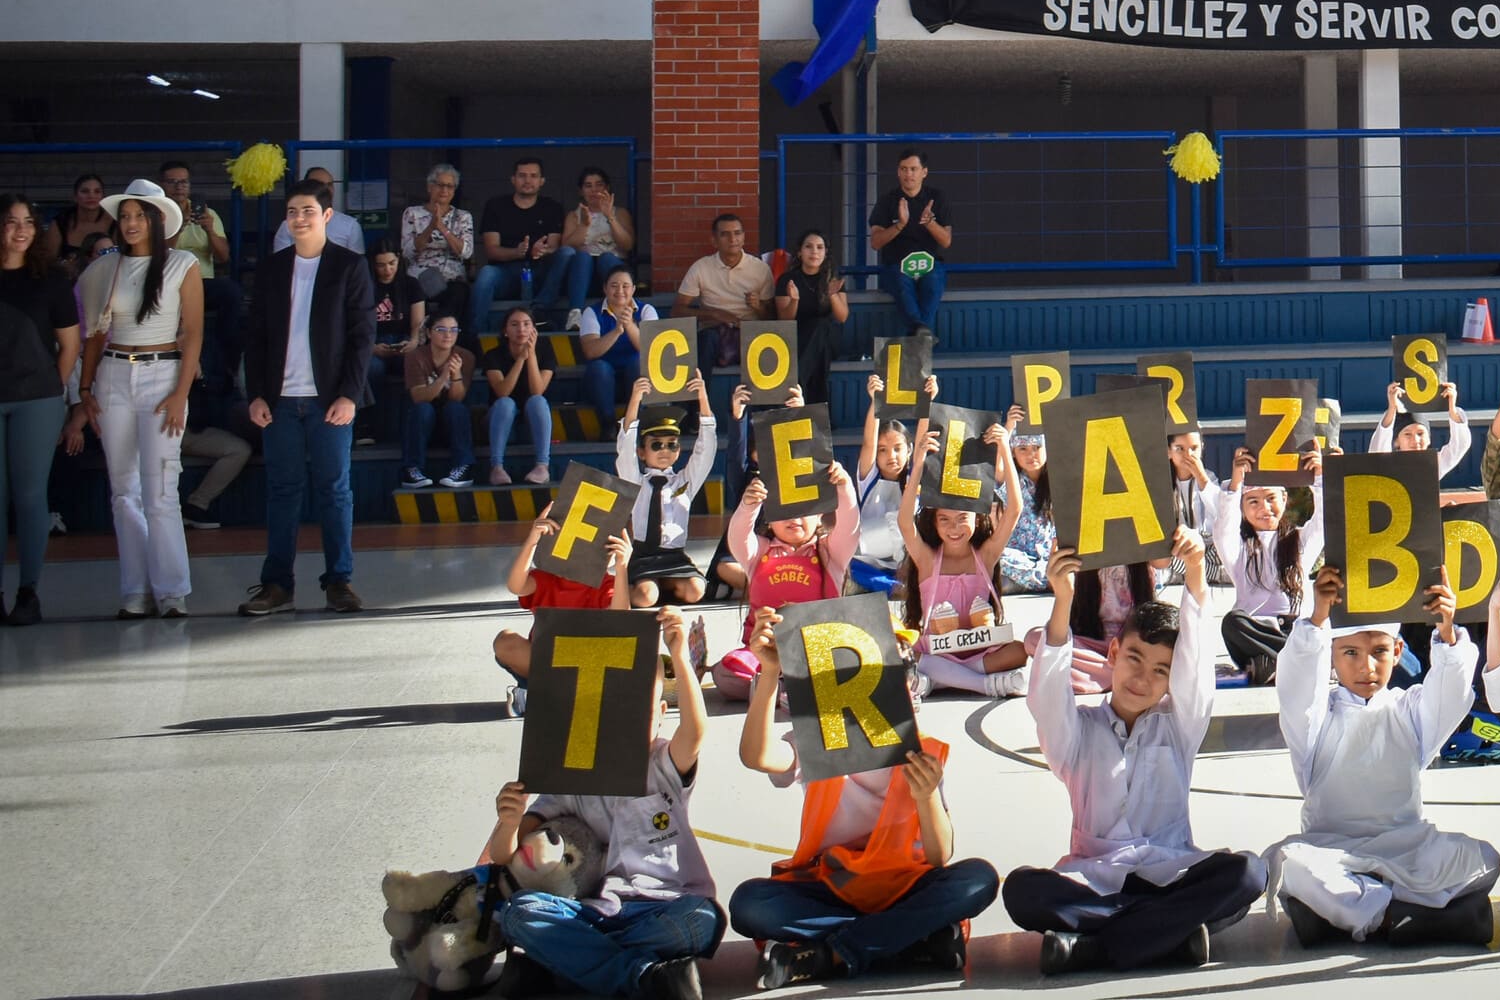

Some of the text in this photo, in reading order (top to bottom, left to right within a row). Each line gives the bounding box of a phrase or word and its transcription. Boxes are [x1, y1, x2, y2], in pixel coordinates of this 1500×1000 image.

[1259, 3, 1282, 37] Y
[908, 260, 928, 271] 3B
[647, 328, 690, 395] C
[745, 332, 791, 391] O
[885, 344, 917, 406] L
[1024, 363, 1064, 426] P
[1146, 364, 1189, 425] R
[1402, 338, 1439, 405] S
[771, 418, 820, 506] E
[941, 419, 982, 499] L
[1257, 396, 1303, 472] Z
[1077, 415, 1166, 557] A
[551, 480, 619, 561] F
[1343, 475, 1421, 615] B
[768, 571, 810, 586] ISABEL
[1443, 520, 1499, 610] D
[931, 629, 991, 651] ICE CREAM
[552, 636, 637, 770] T
[801, 622, 902, 751] R
